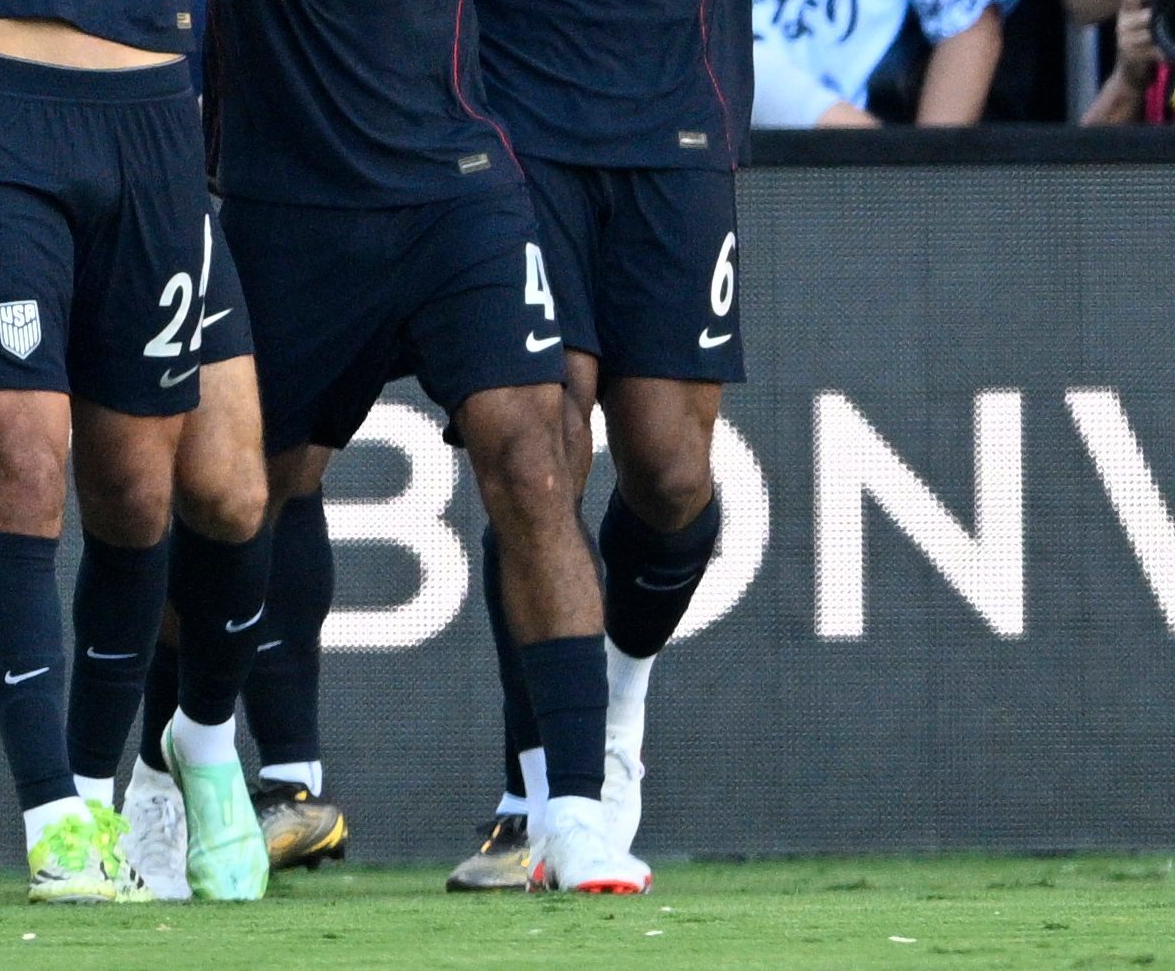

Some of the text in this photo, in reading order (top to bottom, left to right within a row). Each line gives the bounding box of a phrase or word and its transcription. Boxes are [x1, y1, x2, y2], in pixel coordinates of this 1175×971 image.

[143, 272, 205, 357] 2
[525, 241, 555, 321] 4
[710, 231, 736, 317] 6
[0, 303, 36, 328] USA
